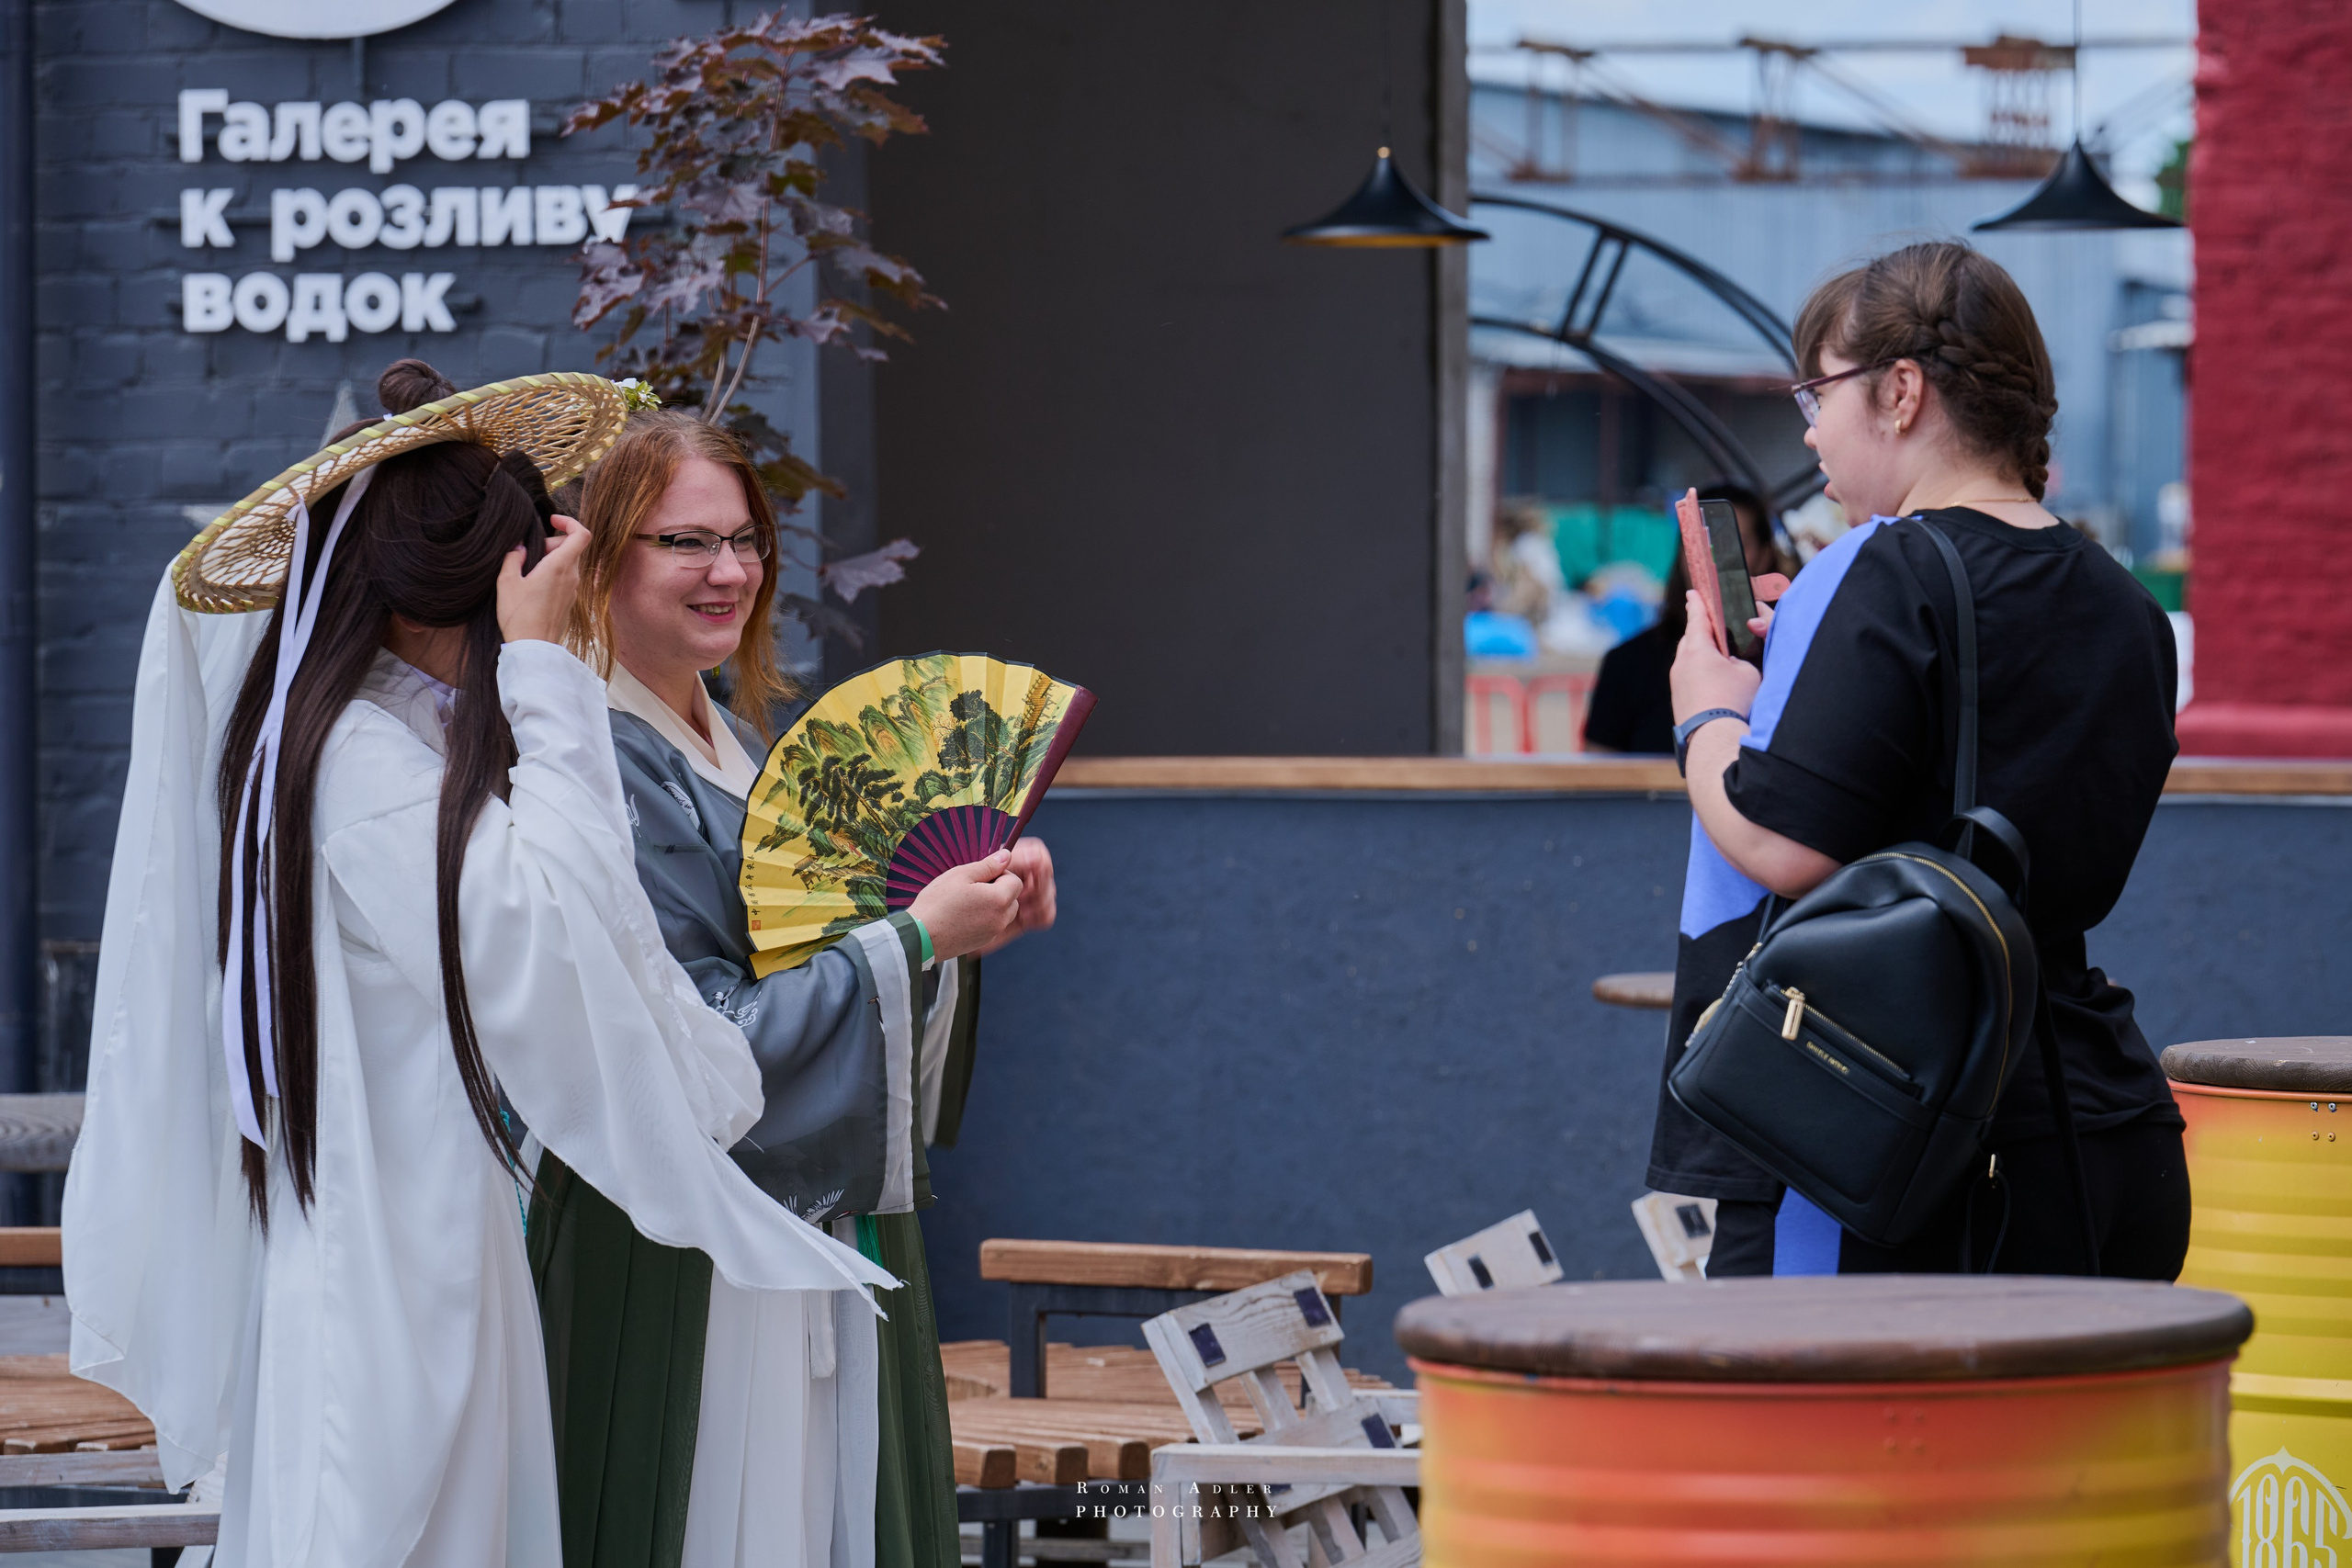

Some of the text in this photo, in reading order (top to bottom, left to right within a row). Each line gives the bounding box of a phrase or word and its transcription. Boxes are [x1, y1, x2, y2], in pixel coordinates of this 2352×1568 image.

[178, 88, 530, 174] Галерея
[181, 183, 639, 263] к розливу
[183, 271, 457, 343] водок
[2237, 1473, 2338, 1568] 1865
